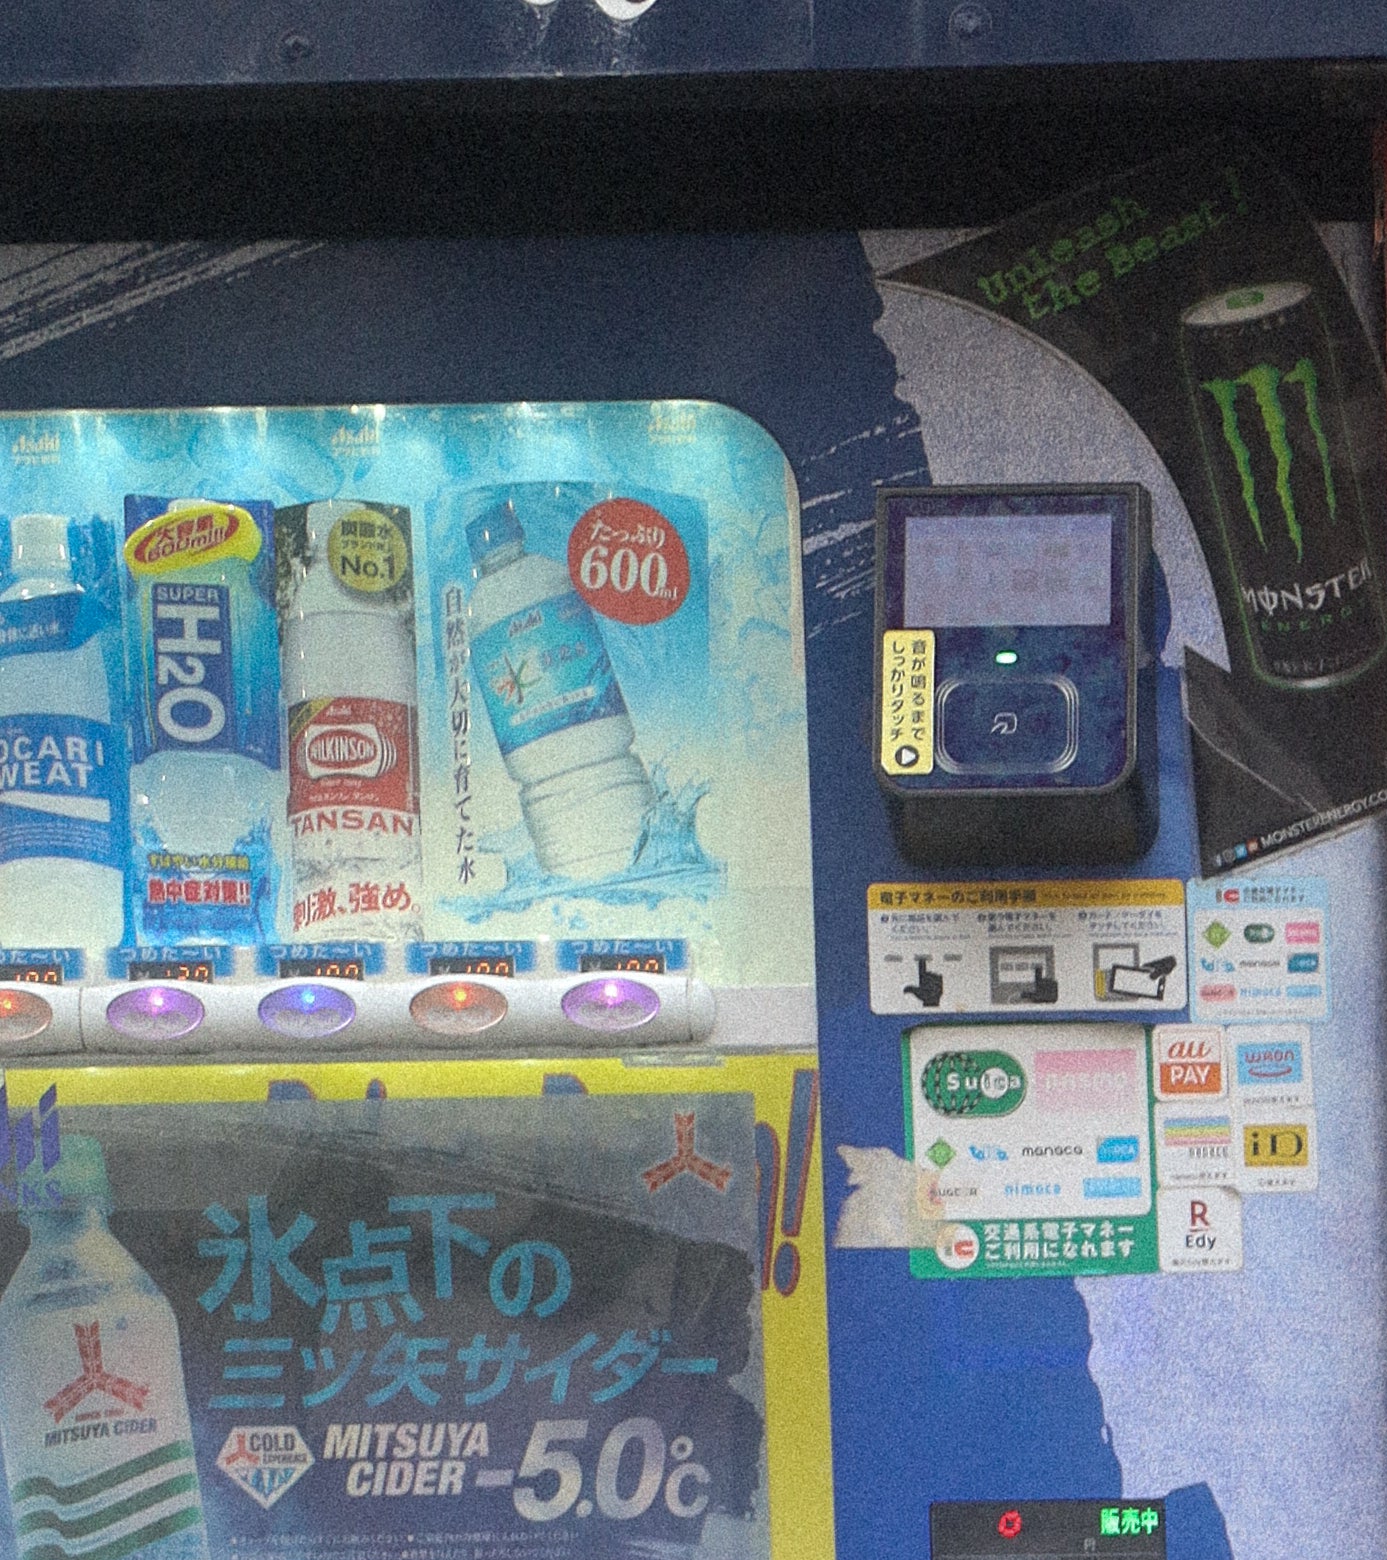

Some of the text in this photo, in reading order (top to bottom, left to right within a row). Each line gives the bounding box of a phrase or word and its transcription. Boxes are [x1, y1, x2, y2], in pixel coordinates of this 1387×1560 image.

[589, 518, 667, 546] たっぷり
[339, 553, 396, 581] No.1
[156, 585, 219, 602] SUPER
[156, 603, 226, 745] H2O
[290, 809, 414, 838] TANSAN
[1167, 1039, 1213, 1060] au
[945, 1070, 1024, 1094] Suica
[1169, 1066, 1210, 1086] PAY
[1021, 1143, 1084, 1158] manaca
[1185, 1233, 1218, 1252] Edy
[198, 1193, 572, 1334] 氷点下の
[207, 1331, 720, 1409] 三ツ矢サイダー
[249, 1431, 296, 1452] COLD
[321, 1423, 490, 1458] MITSUYA
[345, 1459, 469, 1498] CIDER
[1099, 1507, 1160, 1537] 販売中
